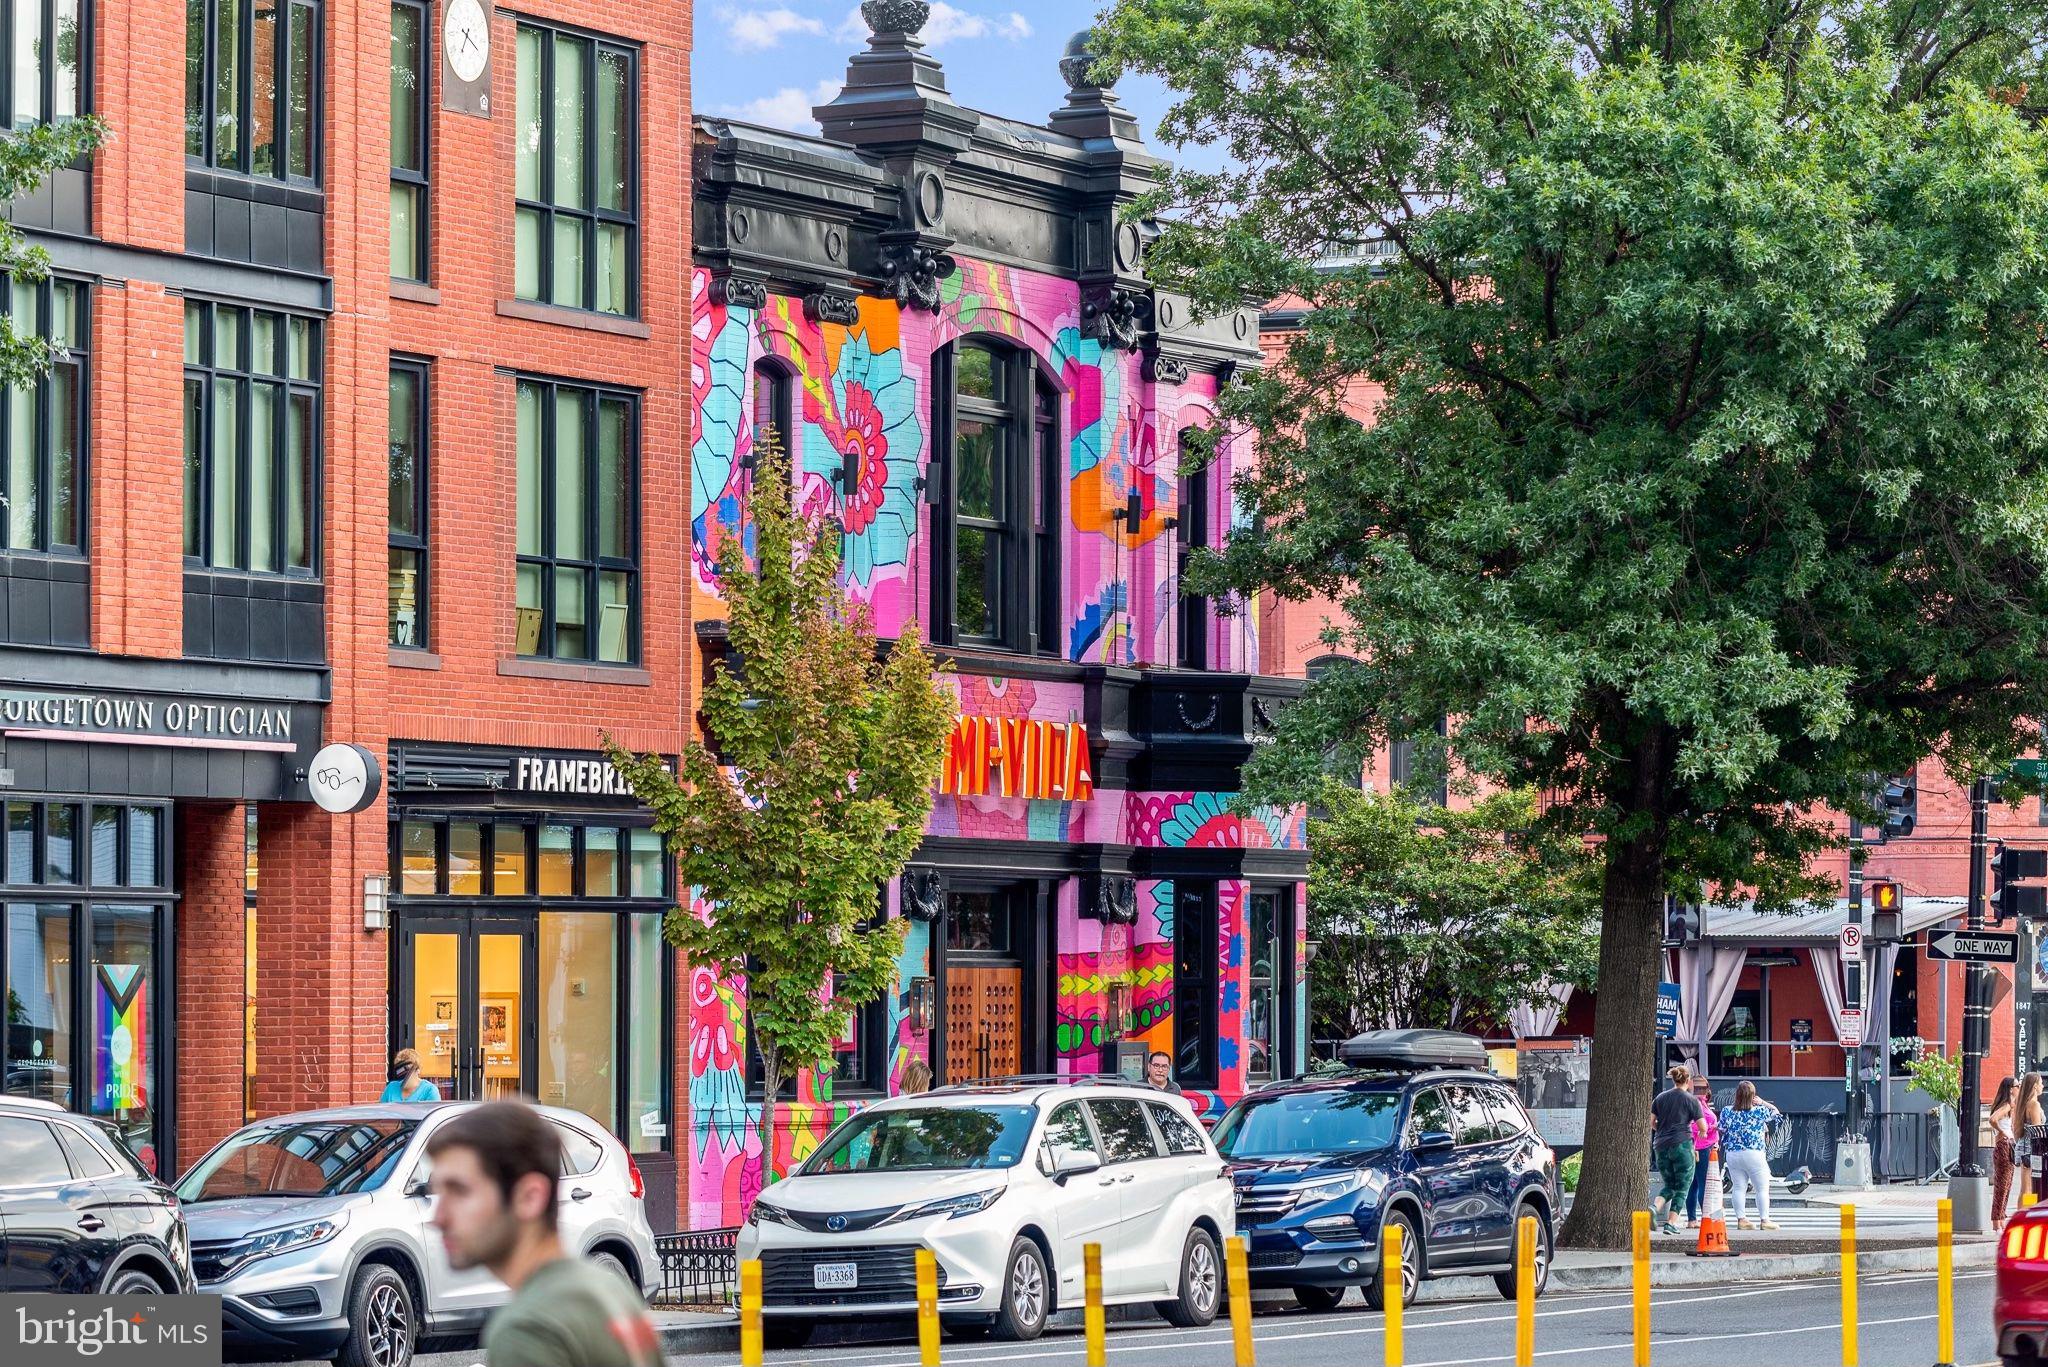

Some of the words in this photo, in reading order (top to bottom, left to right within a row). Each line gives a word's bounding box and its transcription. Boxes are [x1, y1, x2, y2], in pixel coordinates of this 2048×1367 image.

[0, 698, 153, 729] ORGETOWN
[166, 702, 291, 737] OPTICIAN
[517, 757, 671, 795] FRAMEBRI
[1954, 940, 1979, 952] ONE
[1983, 941, 2008, 953] WAY
[2015, 1002, 2031, 1010] 1847
[106, 1083, 138, 1099] PRIDE
[817, 1270, 855, 1283] UDA-3368
